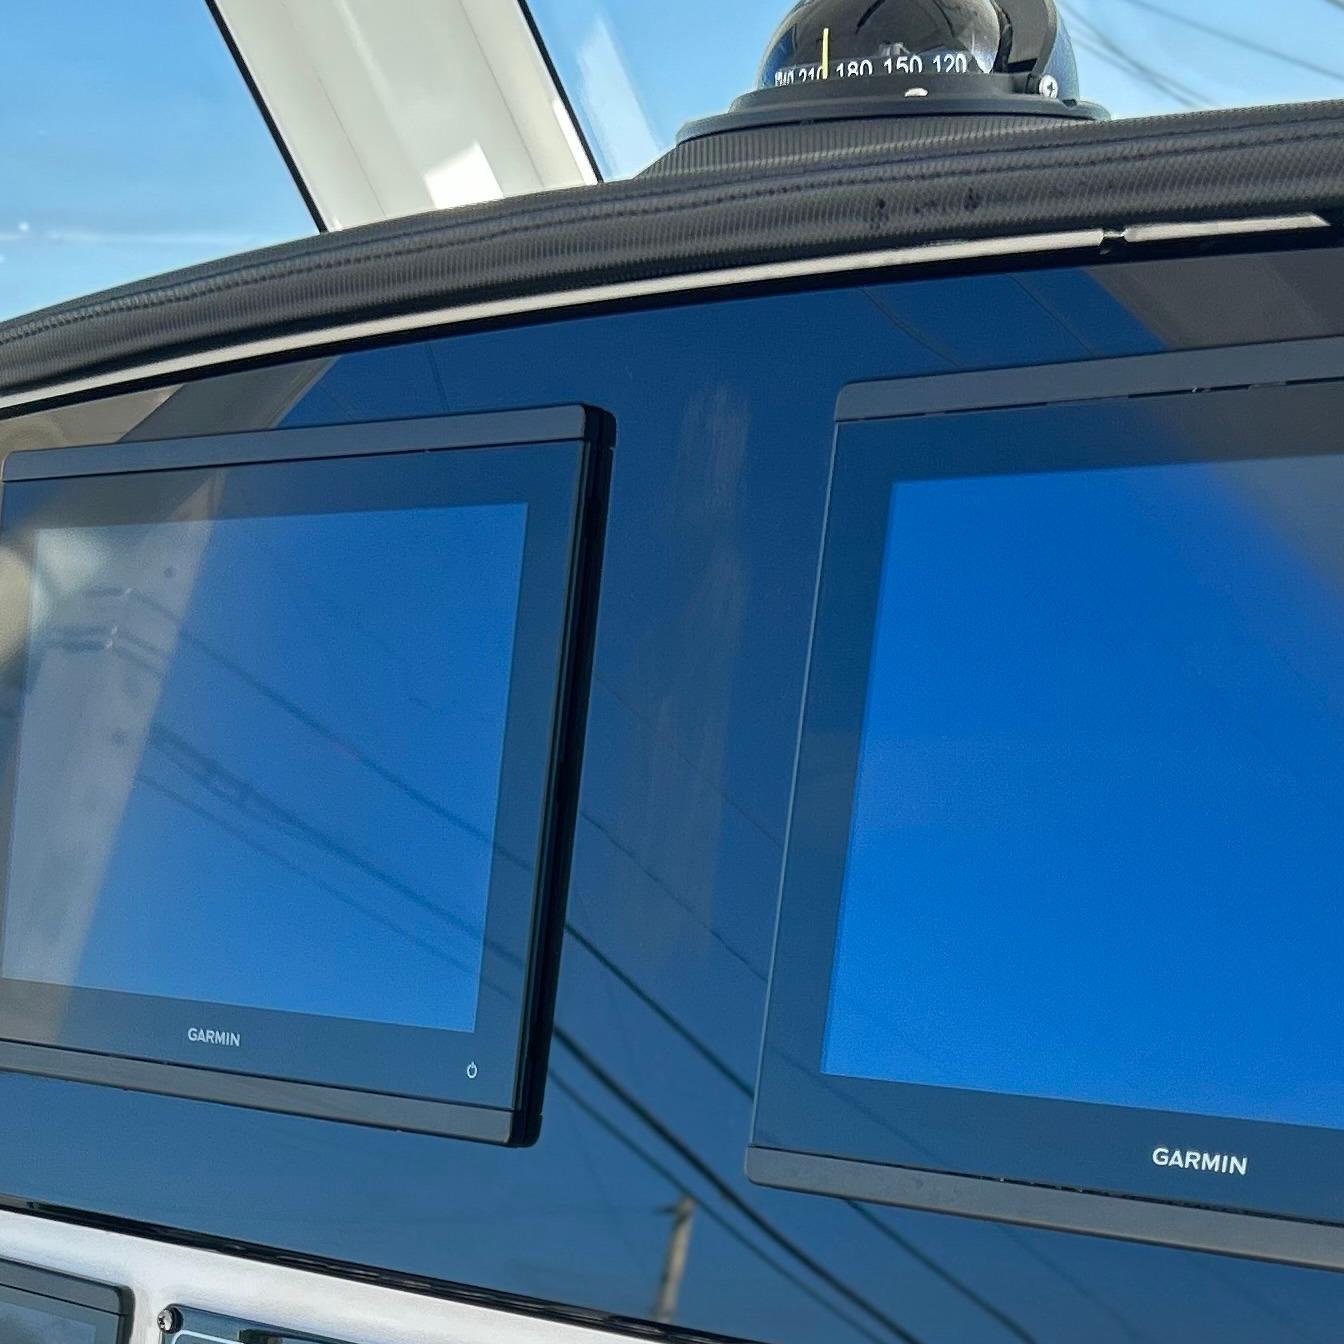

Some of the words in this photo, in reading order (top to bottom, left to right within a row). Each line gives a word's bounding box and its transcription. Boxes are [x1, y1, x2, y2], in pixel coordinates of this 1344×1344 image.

[836, 60, 873, 77] 180
[884, 55, 923, 74] 150
[933, 53, 967, 73] 120
[188, 1027, 240, 1047] GARMIN
[1152, 1147, 1248, 1176] GARMIN
